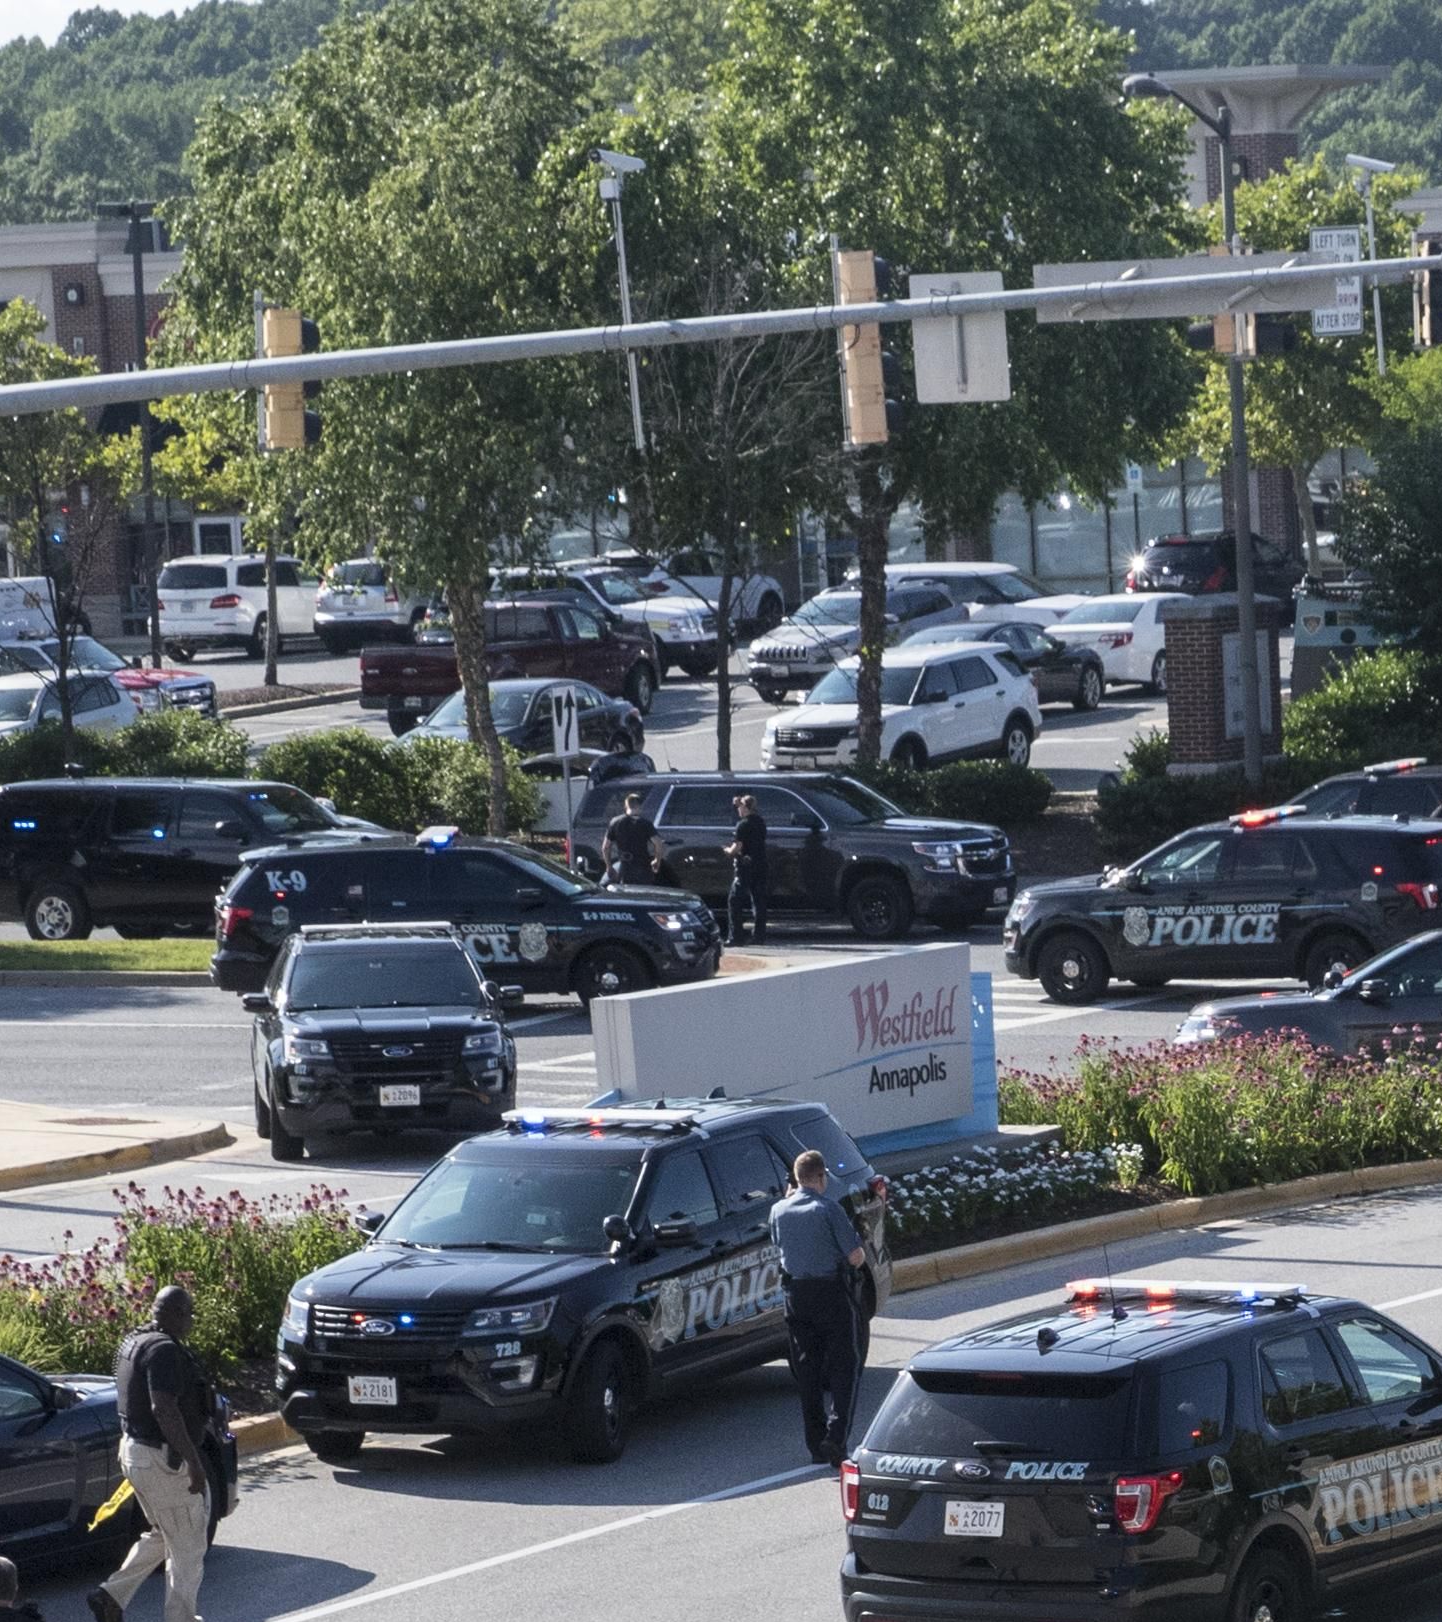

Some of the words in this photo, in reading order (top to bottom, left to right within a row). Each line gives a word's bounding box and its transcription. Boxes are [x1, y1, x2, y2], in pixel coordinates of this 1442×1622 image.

[1315, 234, 1333, 248] LEFT
[1336, 232, 1356, 247] TURN
[1339, 293, 1358, 306] RROW
[1316, 313, 1339, 329] AFTER
[1341, 311, 1360, 327] STOP
[265, 870, 307, 892] K-9
[582, 912, 598, 921] K-9
[600, 912, 636, 922] PATROL
[1157, 906, 1185, 916] ANNE
[1186, 904, 1236, 915] ARUNDEL
[1238, 903, 1281, 914] COUNTY
[462, 923, 507, 934] COUNTY
[1149, 914, 1279, 946] POLICE
[849, 979, 958, 1053] Westfield
[869, 1052, 947, 1097] Annapolis
[684, 1262, 784, 1340] POLIC
[876, 1456, 947, 1476] COUNTY
[962, 1464, 983, 1476] Ford
[1005, 1462, 1090, 1481] POLICE
[1318, 1464, 1349, 1486] ANNE
[1350, 1453, 1399, 1479] ARUNDEL
[1401, 1440, 1442, 1464] COUNTY
